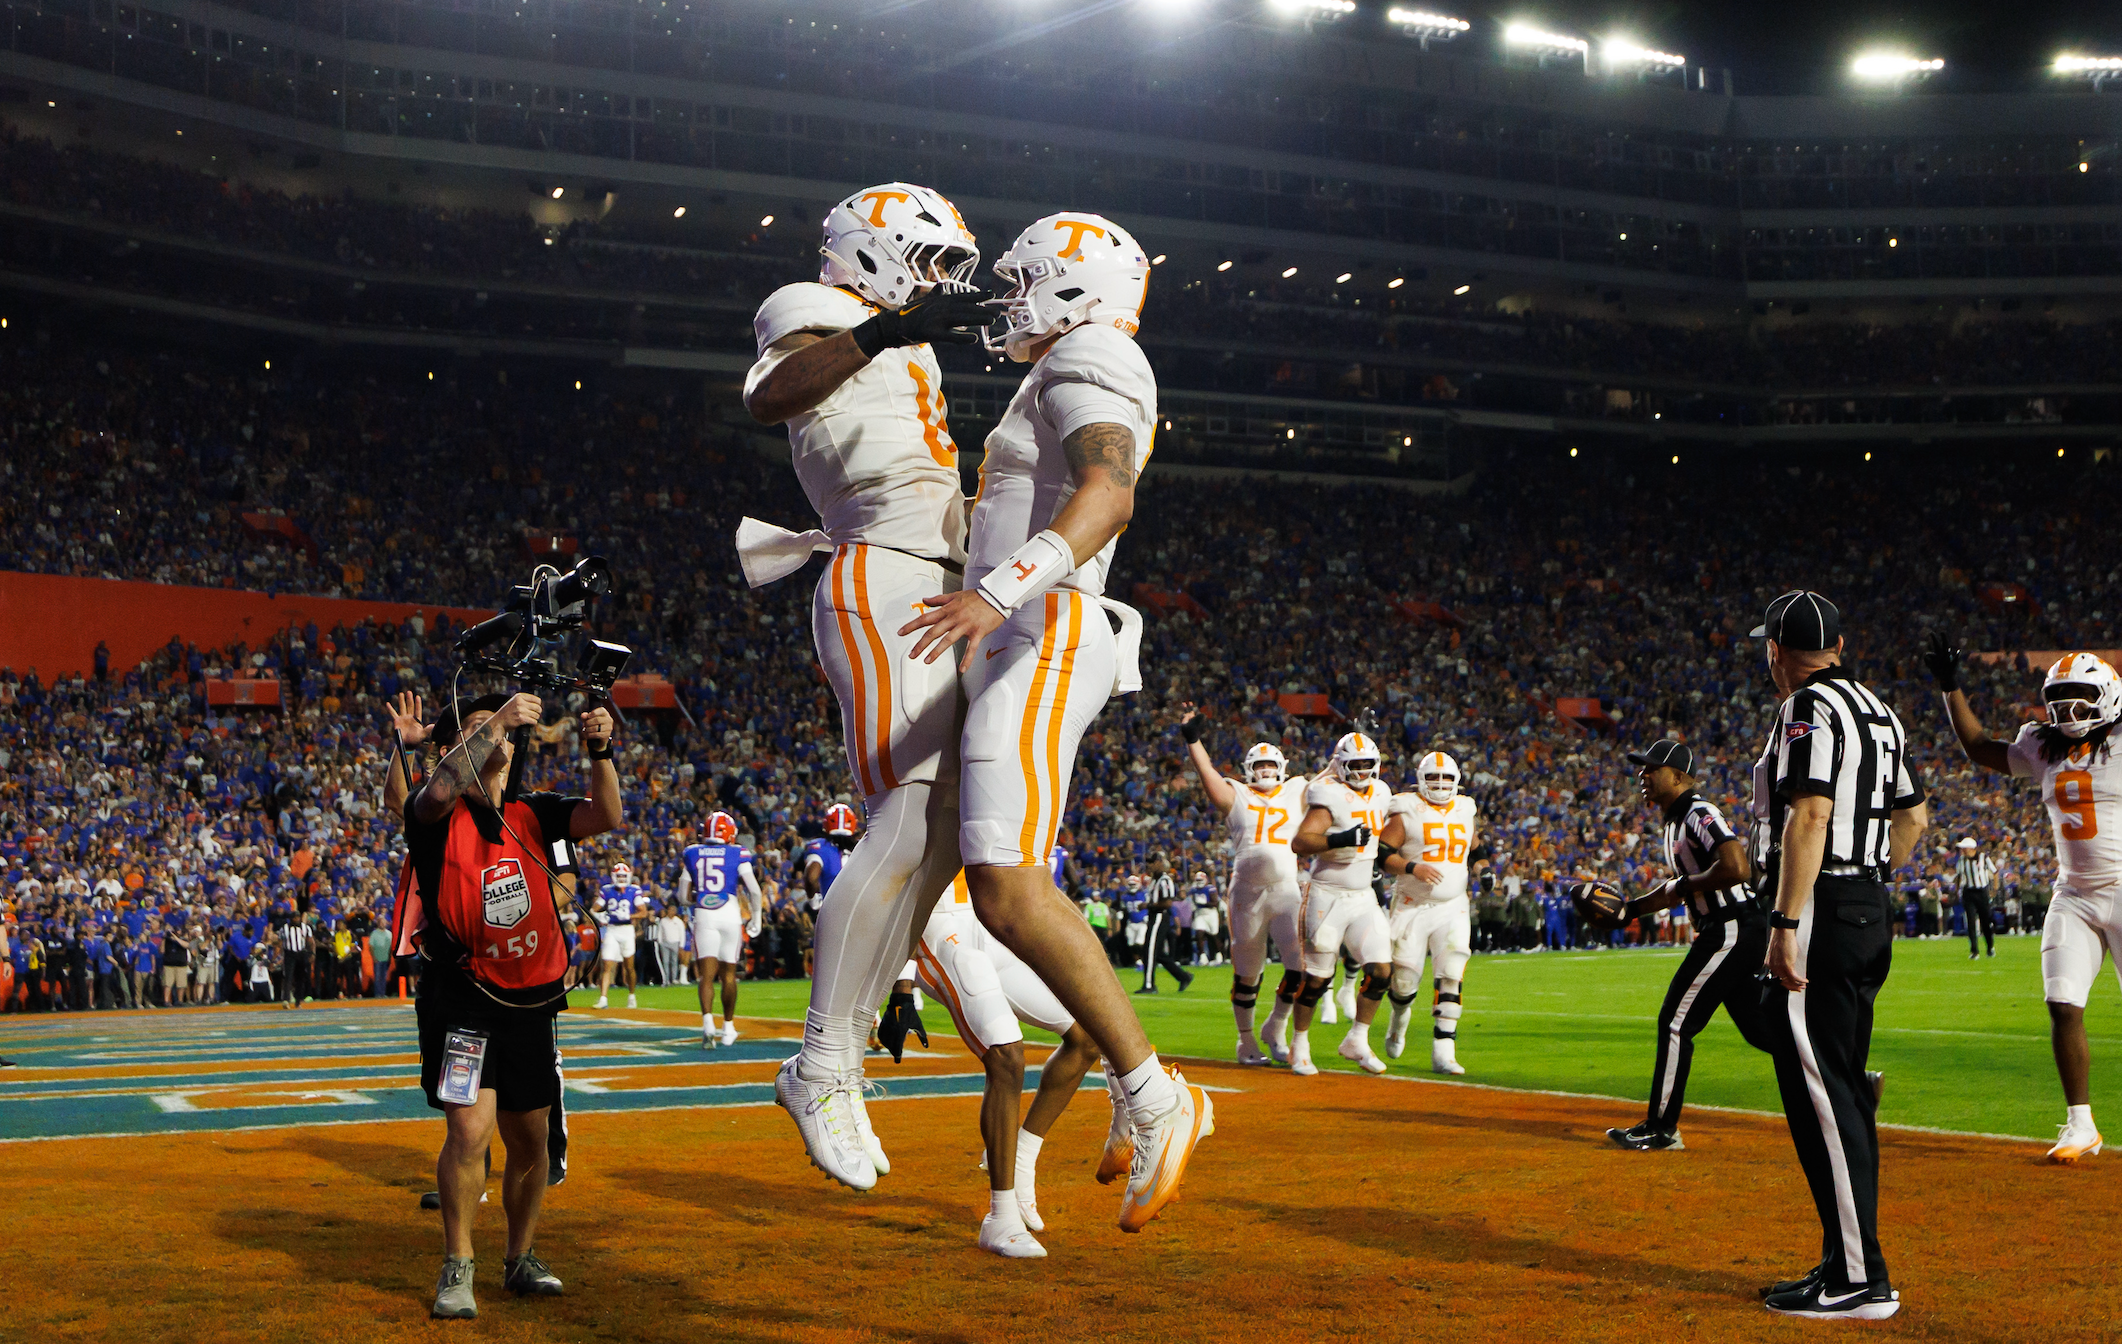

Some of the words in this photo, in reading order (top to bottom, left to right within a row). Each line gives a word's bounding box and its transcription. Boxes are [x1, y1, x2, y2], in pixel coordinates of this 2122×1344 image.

[861, 191, 911, 228] T
[1054, 220, 1106, 263] T
[1011, 559, 1038, 583] T
[1868, 723, 1897, 809] F
[2055, 770, 2098, 841] 9
[1247, 804, 1290, 845] 72
[1423, 822, 1468, 864] 56
[698, 847, 726, 856] WOODS
[696, 857, 725, 893] 15
[486, 930, 539, 959] 159
[945, 932, 960, 946] T
